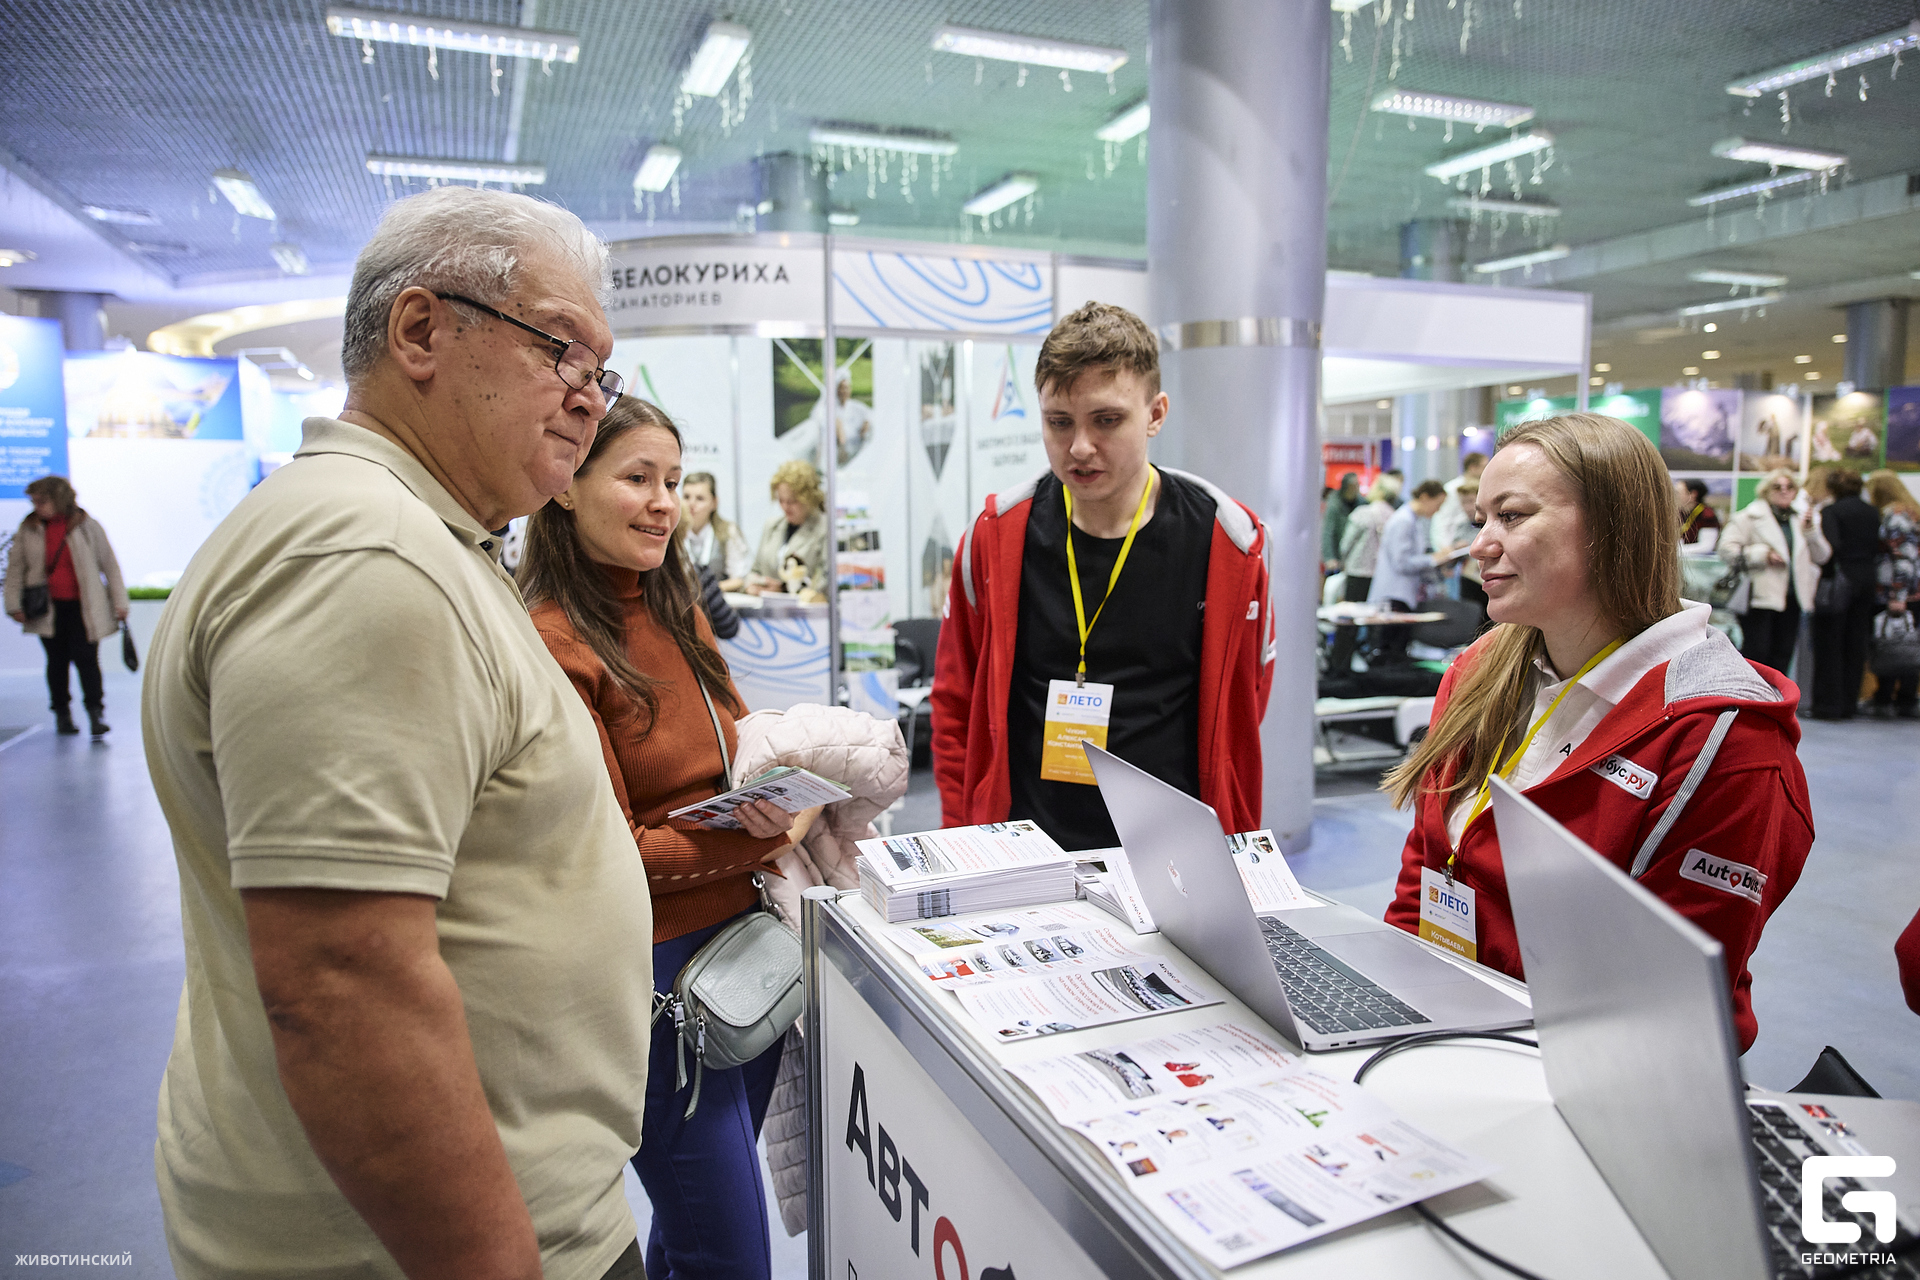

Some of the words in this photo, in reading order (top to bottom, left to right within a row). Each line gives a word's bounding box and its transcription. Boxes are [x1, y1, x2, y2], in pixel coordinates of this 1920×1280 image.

[613, 262, 790, 290] БЕЛОКУРИХА
[1069, 695, 1103, 707] ЛЕТО
[1440, 891, 1469, 916] ЛЕТО
